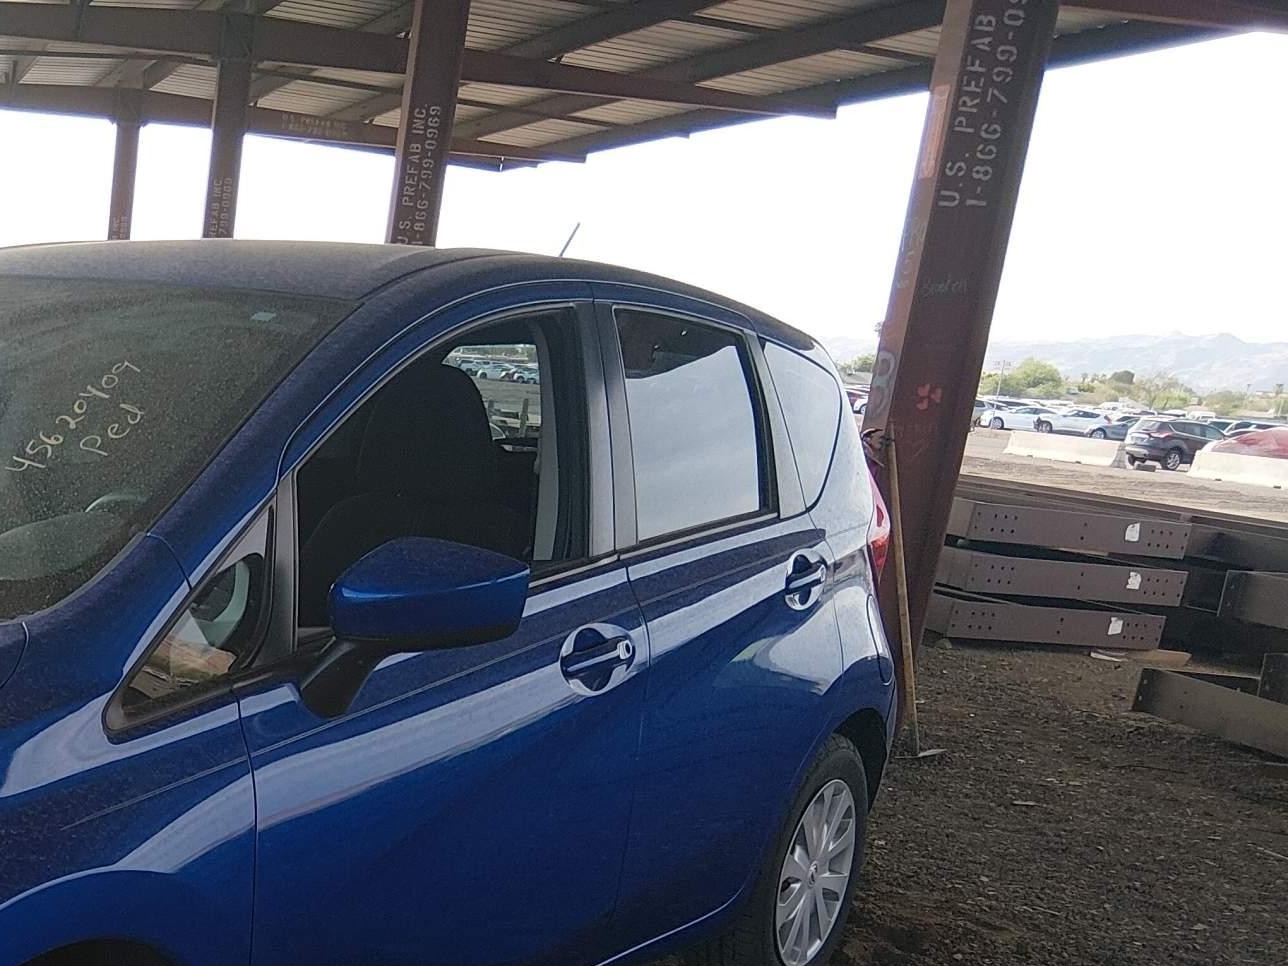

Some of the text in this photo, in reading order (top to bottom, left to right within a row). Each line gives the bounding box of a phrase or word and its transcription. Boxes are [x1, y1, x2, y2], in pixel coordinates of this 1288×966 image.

[402, 143, 422, 206] PREFAB
[412, 104, 427, 134] INC.
[937, 14, 997, 207] U.S. PREFAB
[4, 360, 141, 472] 45620409
